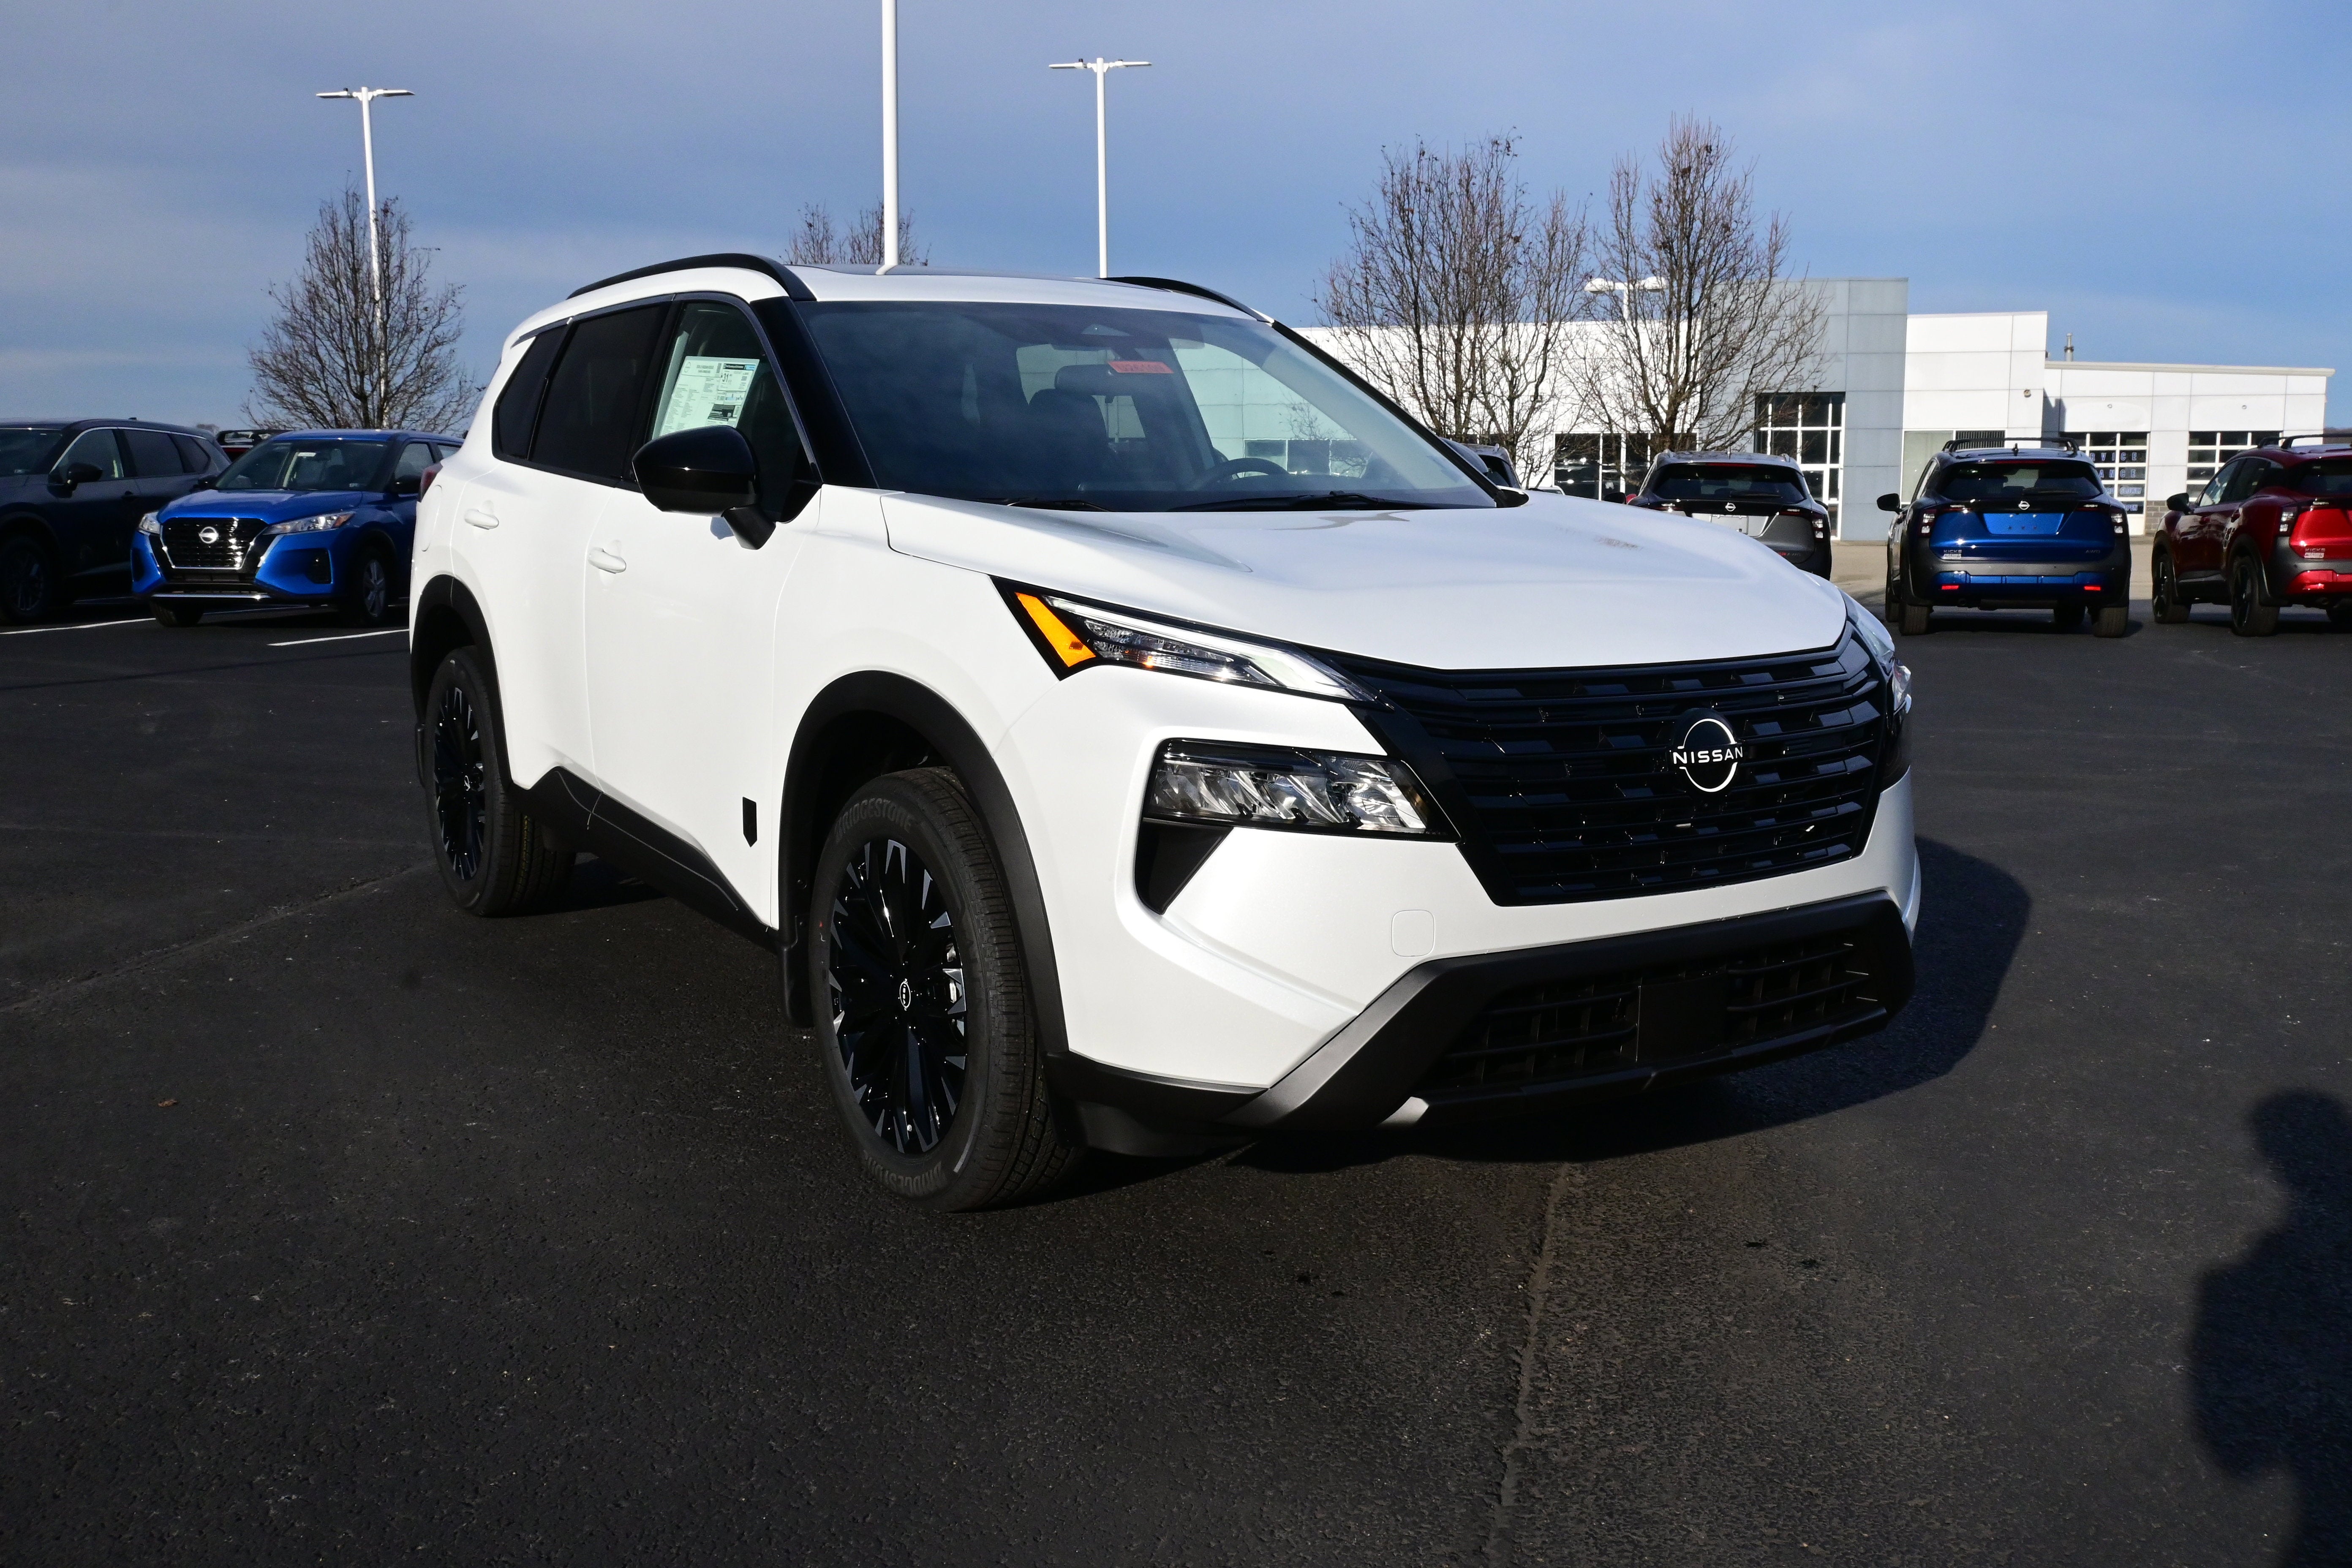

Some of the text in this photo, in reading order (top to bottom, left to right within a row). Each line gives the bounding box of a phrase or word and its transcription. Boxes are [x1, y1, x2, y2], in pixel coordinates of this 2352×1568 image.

[2090, 452, 2137, 461] RVICE
[2099, 469, 2136, 478] ANCE
[1672, 746, 1743, 764] NISSAN
[834, 798, 912, 843] BRIDGESTONE
